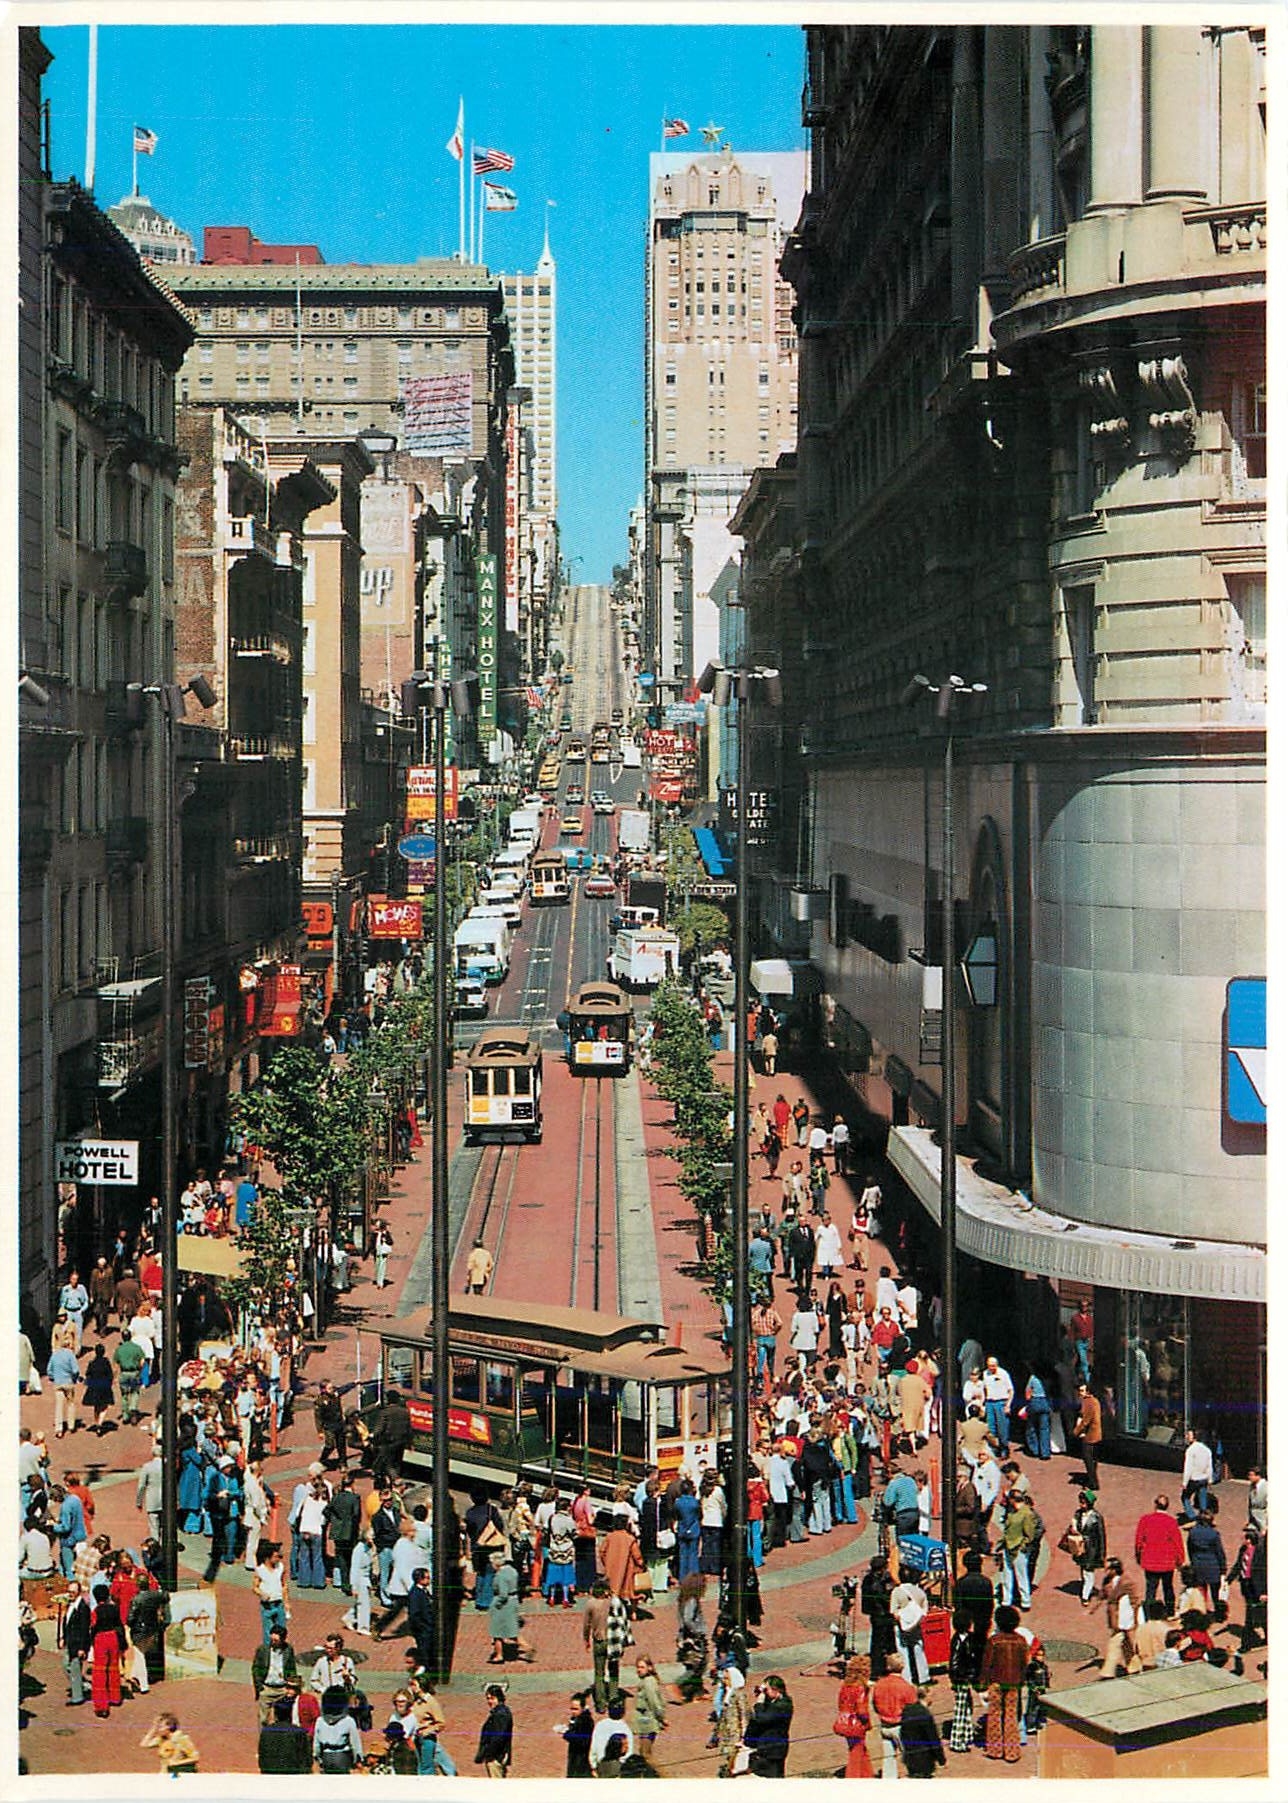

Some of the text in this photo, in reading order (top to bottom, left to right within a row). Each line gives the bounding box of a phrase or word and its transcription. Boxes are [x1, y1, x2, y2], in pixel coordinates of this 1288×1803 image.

[479, 561, 495, 627] MANX
[480, 636, 495, 718] HOTEL
[727, 792, 776, 807] HTEL
[731, 810, 770, 819] GLDEN
[64, 1147, 130, 1158] POWELL
[59, 1162, 133, 1179] HOTEL
